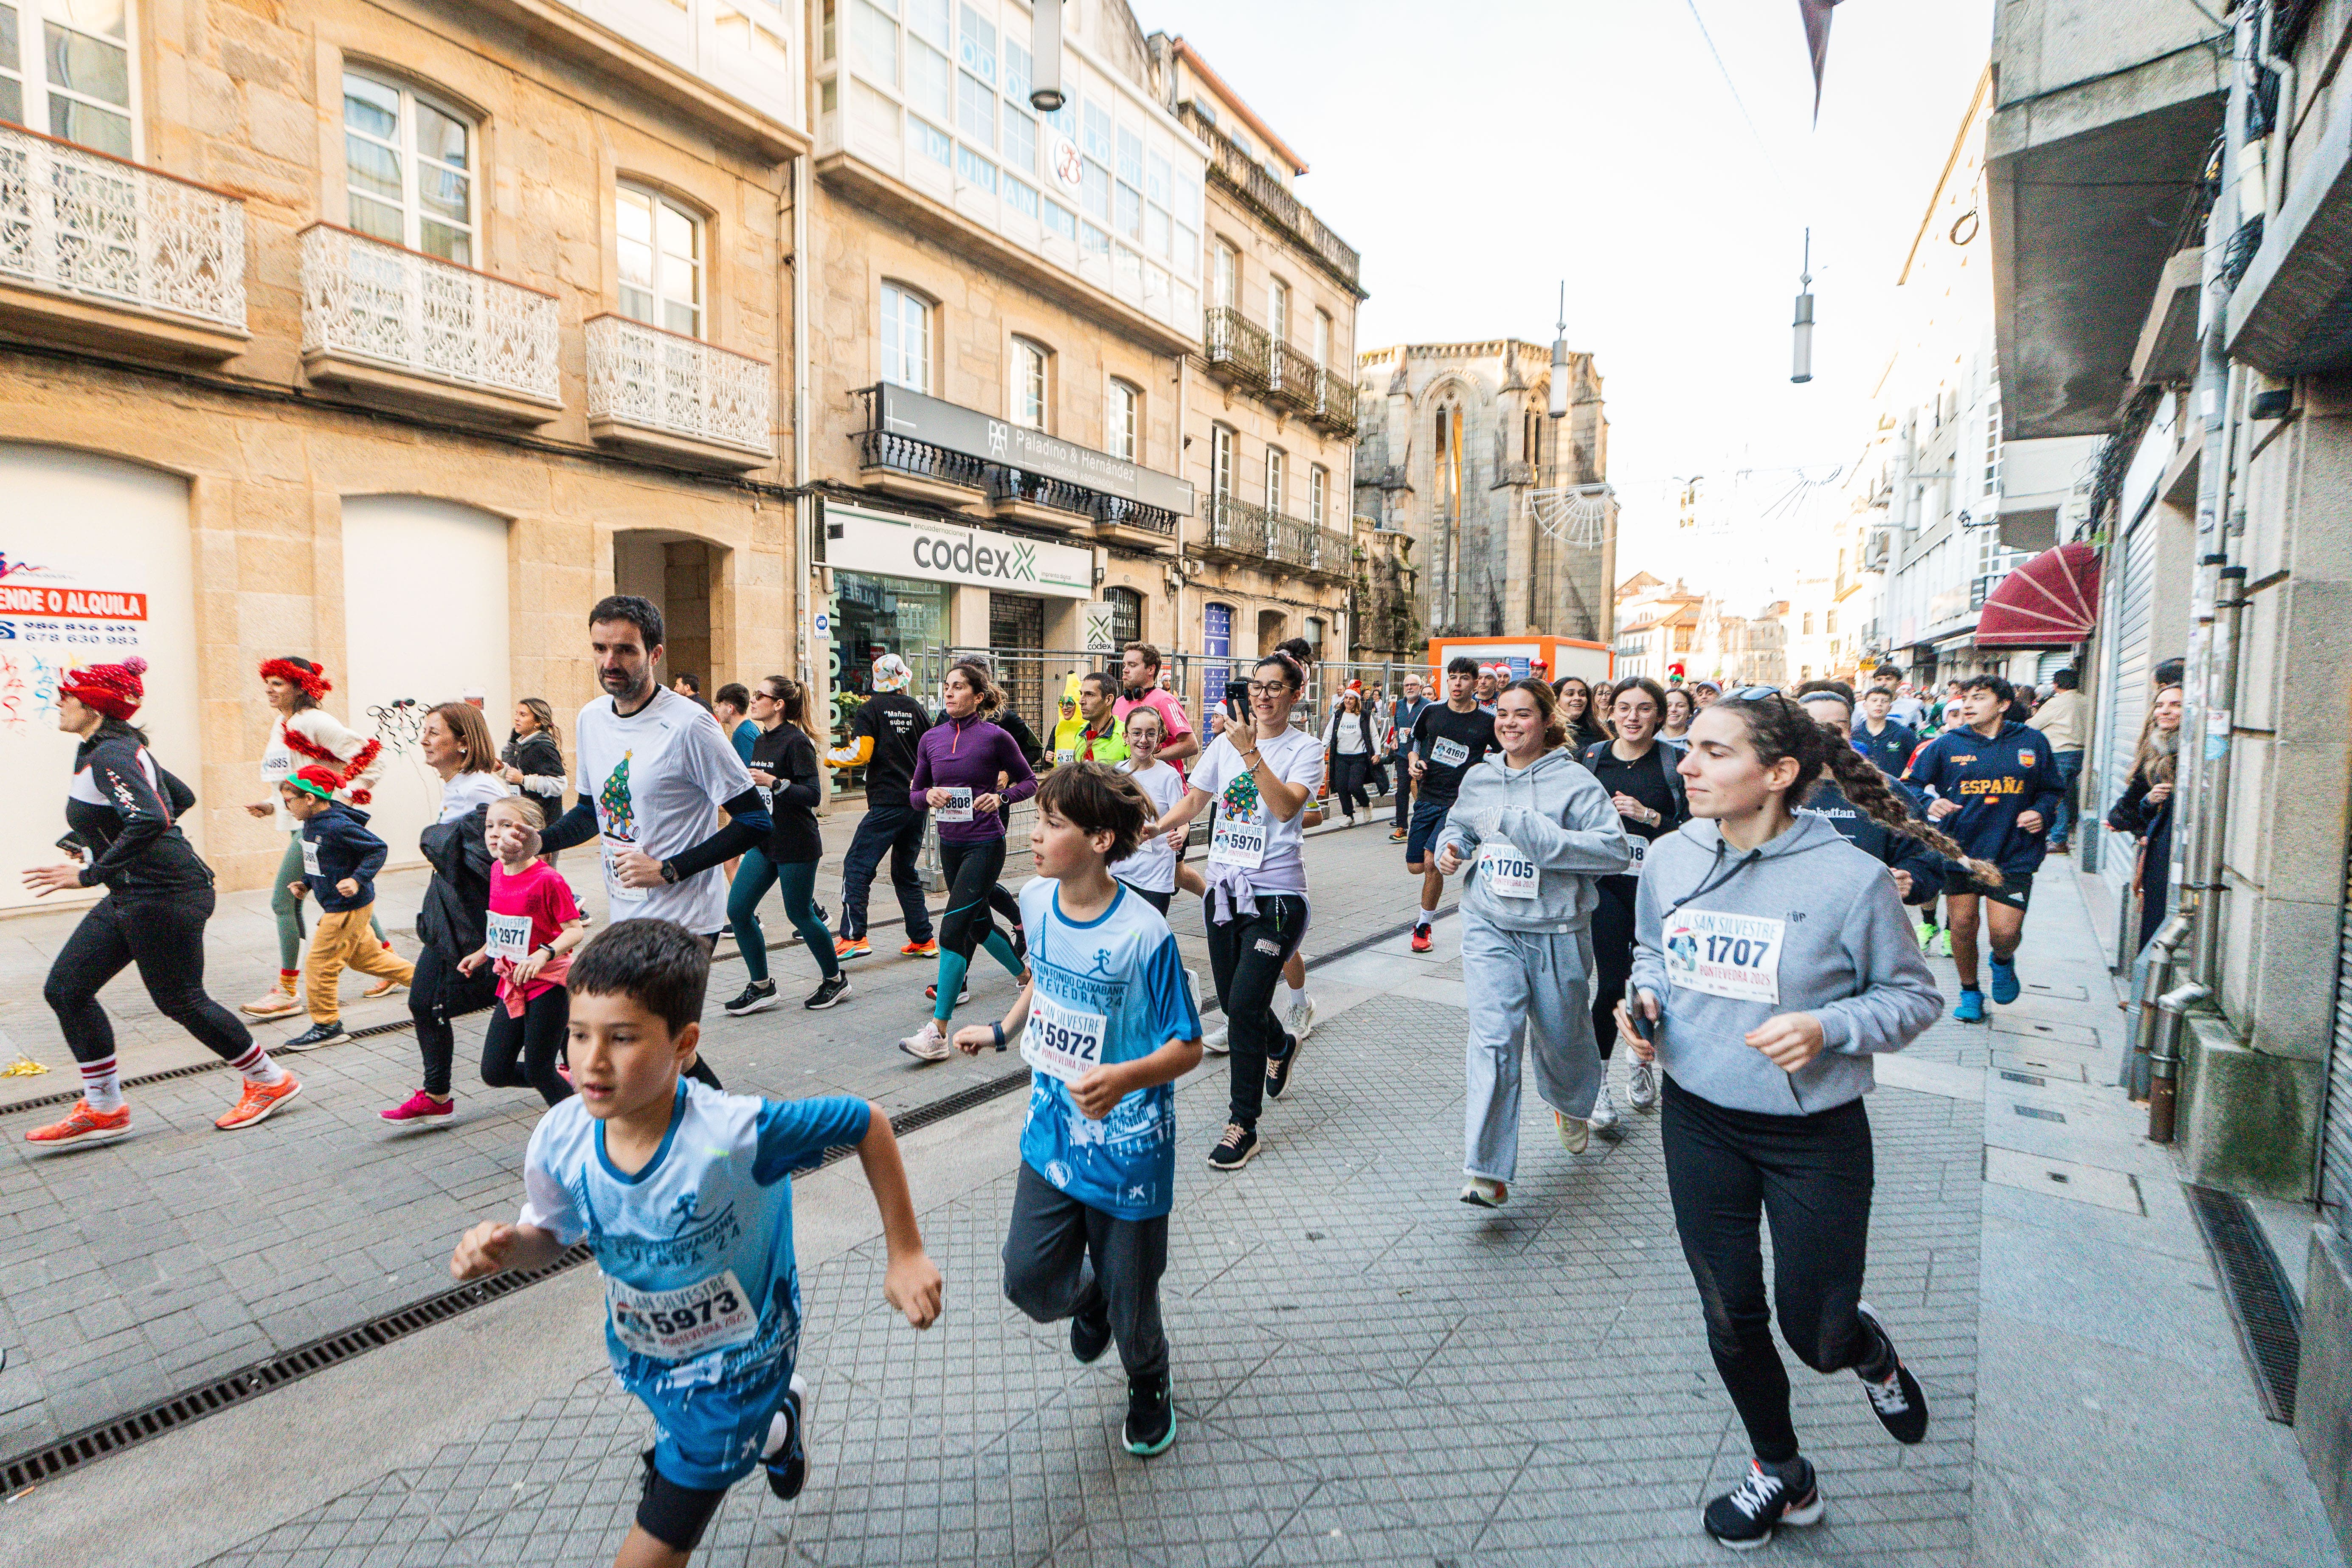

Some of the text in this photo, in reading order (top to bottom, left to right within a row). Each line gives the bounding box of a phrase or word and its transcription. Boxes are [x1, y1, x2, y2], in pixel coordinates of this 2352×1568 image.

[960, 155, 1035, 212] JUAN
[1017, 429, 1134, 481] Paladino & Hernández
[1042, 461, 1114, 489] ABOGADOS ASOCIADOS
[914, 522, 966, 538] encuadernaciones
[913, 532, 1010, 580] codex
[1041, 570, 1072, 581] imprenta digital
[0, 588, 142, 617] ENDE O ALQUILA
[1087, 642, 1112, 650] códex
[1446, 747, 1466, 759] 4160
[1960, 776, 2025, 795] ESPAÑA
[1216, 821, 1263, 836] XLII SAN SILVESTRE
[1230, 833, 1262, 852] 5970
[1228, 850, 1260, 861] PONTEVEDRA 2025
[1497, 859, 1533, 879] 1705
[1494, 877, 1535, 888] PONTEVEDRA 2025
[499, 927, 525, 945] 2971
[1693, 914, 1715, 932] SAN
[1718, 917, 1777, 940] SILVESTRE
[1707, 935, 1770, 968] 1707
[1050, 968, 1075, 987] FONDO
[1076, 978, 1125, 996] CAIXABANK
[1699, 964, 1771, 986] PONTEVEDRA 2025
[1105, 996, 1123, 1008] 24
[1042, 1002, 1055, 1020] SAN
[1056, 1009, 1100, 1034] SILVESTRE
[1045, 1022, 1097, 1061] 5972
[1042, 1047, 1076, 1070] PONTEVEDRA
[649, 1290, 740, 1336] 5973
